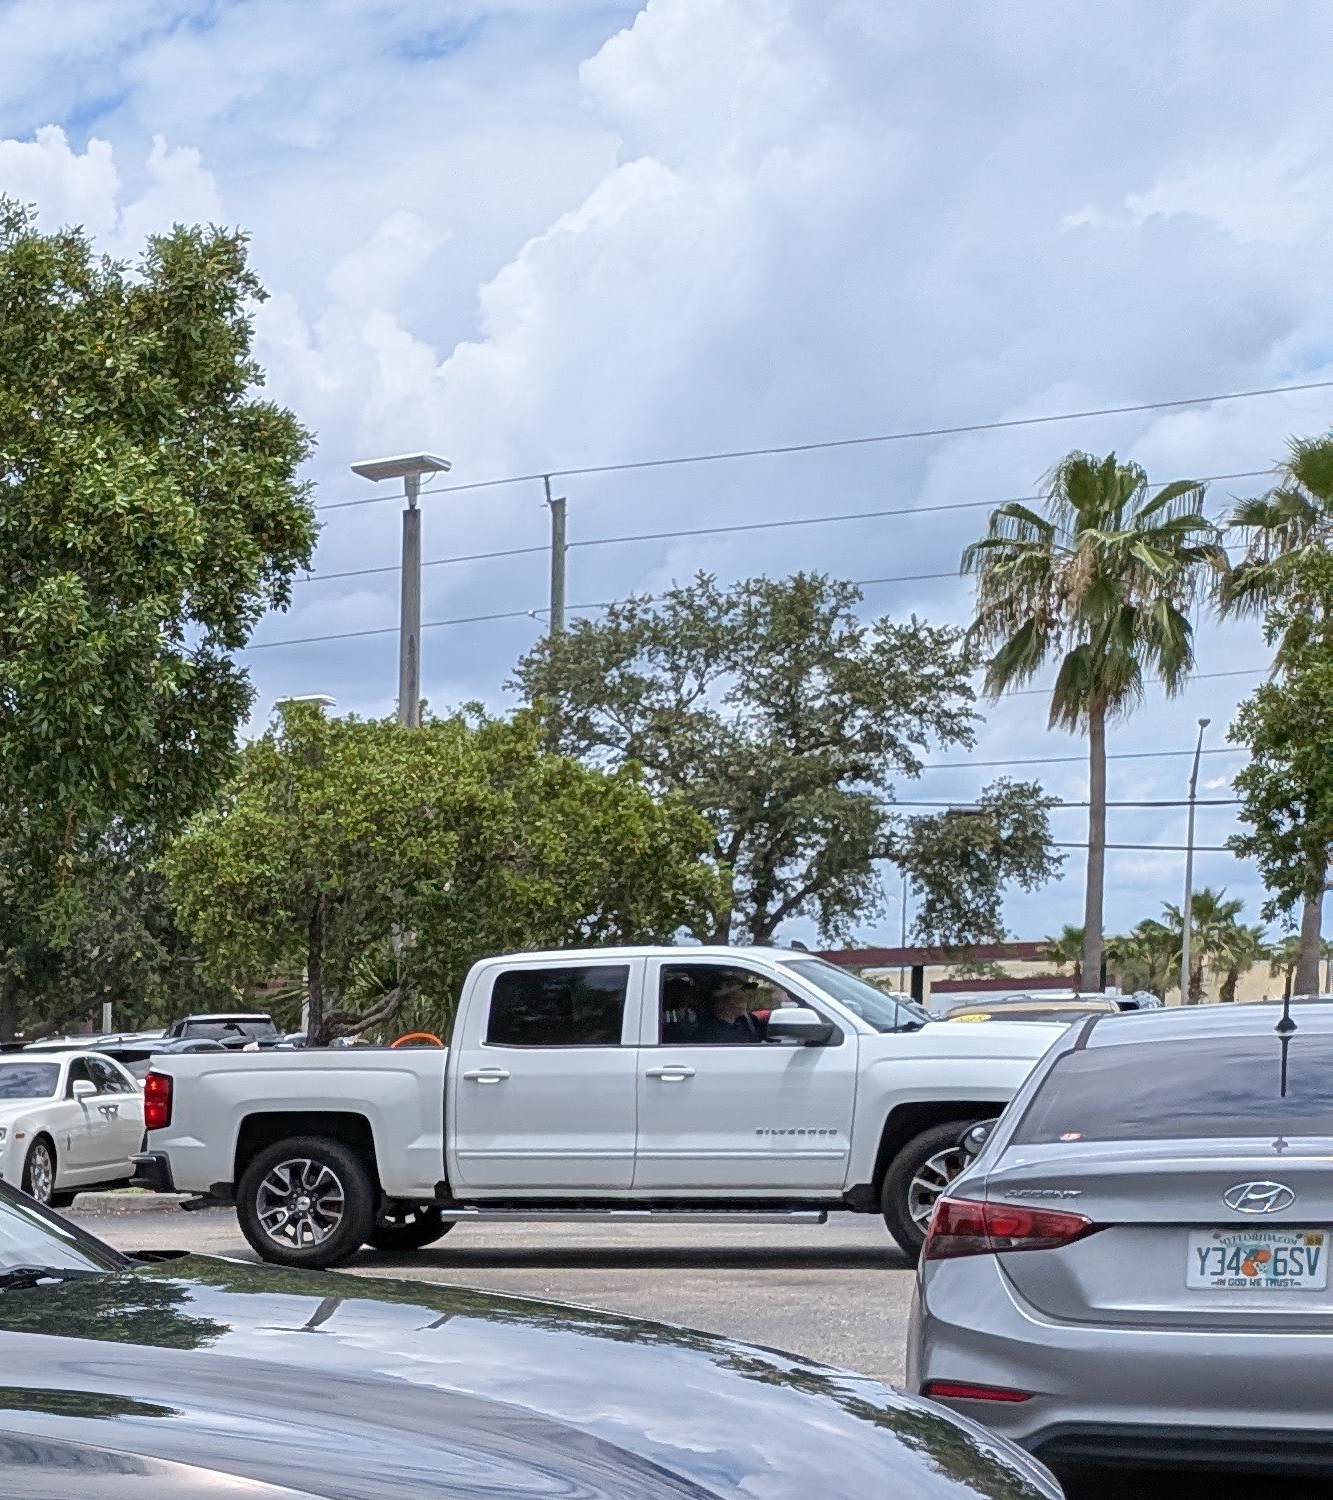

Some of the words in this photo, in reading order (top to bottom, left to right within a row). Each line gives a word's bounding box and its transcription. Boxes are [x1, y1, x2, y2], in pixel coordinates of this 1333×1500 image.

[1227, 1278, 1247, 1287] GOD
[1249, 1278, 1262, 1287] WE
[1265, 1278, 1295, 1287] TRUST
